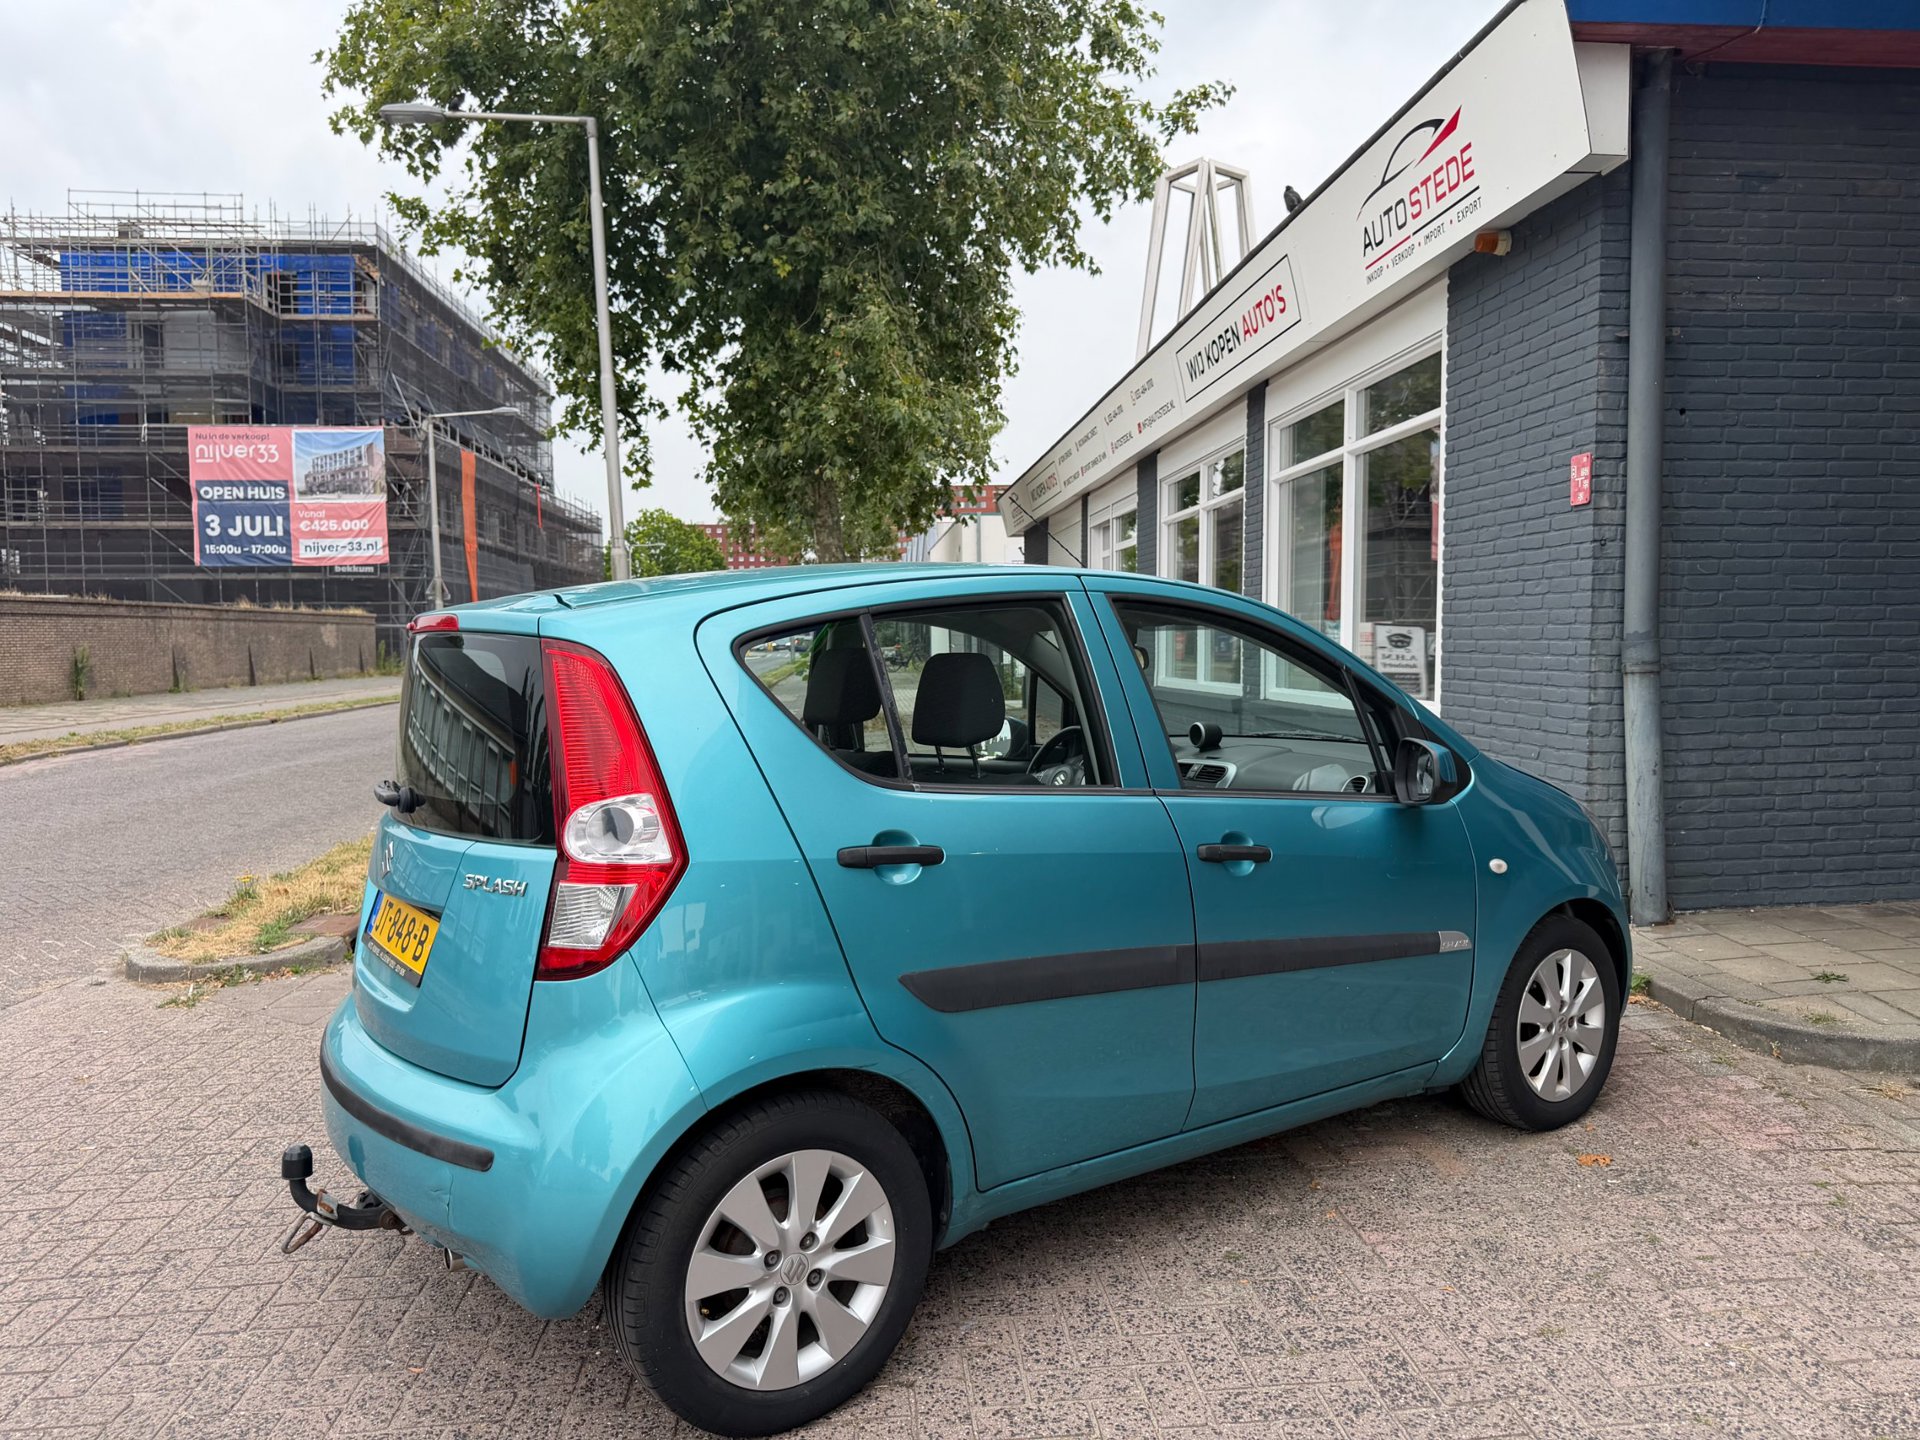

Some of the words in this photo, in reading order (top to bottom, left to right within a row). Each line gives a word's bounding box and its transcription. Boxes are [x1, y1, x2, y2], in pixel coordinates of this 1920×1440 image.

[1366, 265, 1384, 285] INKOOP
[1391, 243, 1416, 267] VERKOOP
[1424, 223, 1445, 246] IMPORT
[1456, 196, 1482, 223] EXPORT
[1185, 351, 1205, 382] WIJ
[1204, 321, 1241, 370] KOPEN
[1242, 284, 1287, 342] AUTO'S
[209, 432, 217, 440] in
[218, 432, 230, 440] de
[231, 432, 270, 441] verkoop!
[200, 486, 244, 499] OPEN
[247, 486, 285, 499] HUIS
[298, 510, 326, 518] Vanaf
[205, 514, 221, 536] 3
[227, 515, 284, 536] JULI
[300, 519, 369, 531] €425.000
[205, 544, 241, 554] 15:00u
[251, 544, 286, 554] 17:00u
[304, 541, 378, 555] nijver-33.nl
[334, 564, 375, 573] bekkum
[462, 873, 528, 897] SPLASH
[375, 899, 430, 962] JT-848-B
